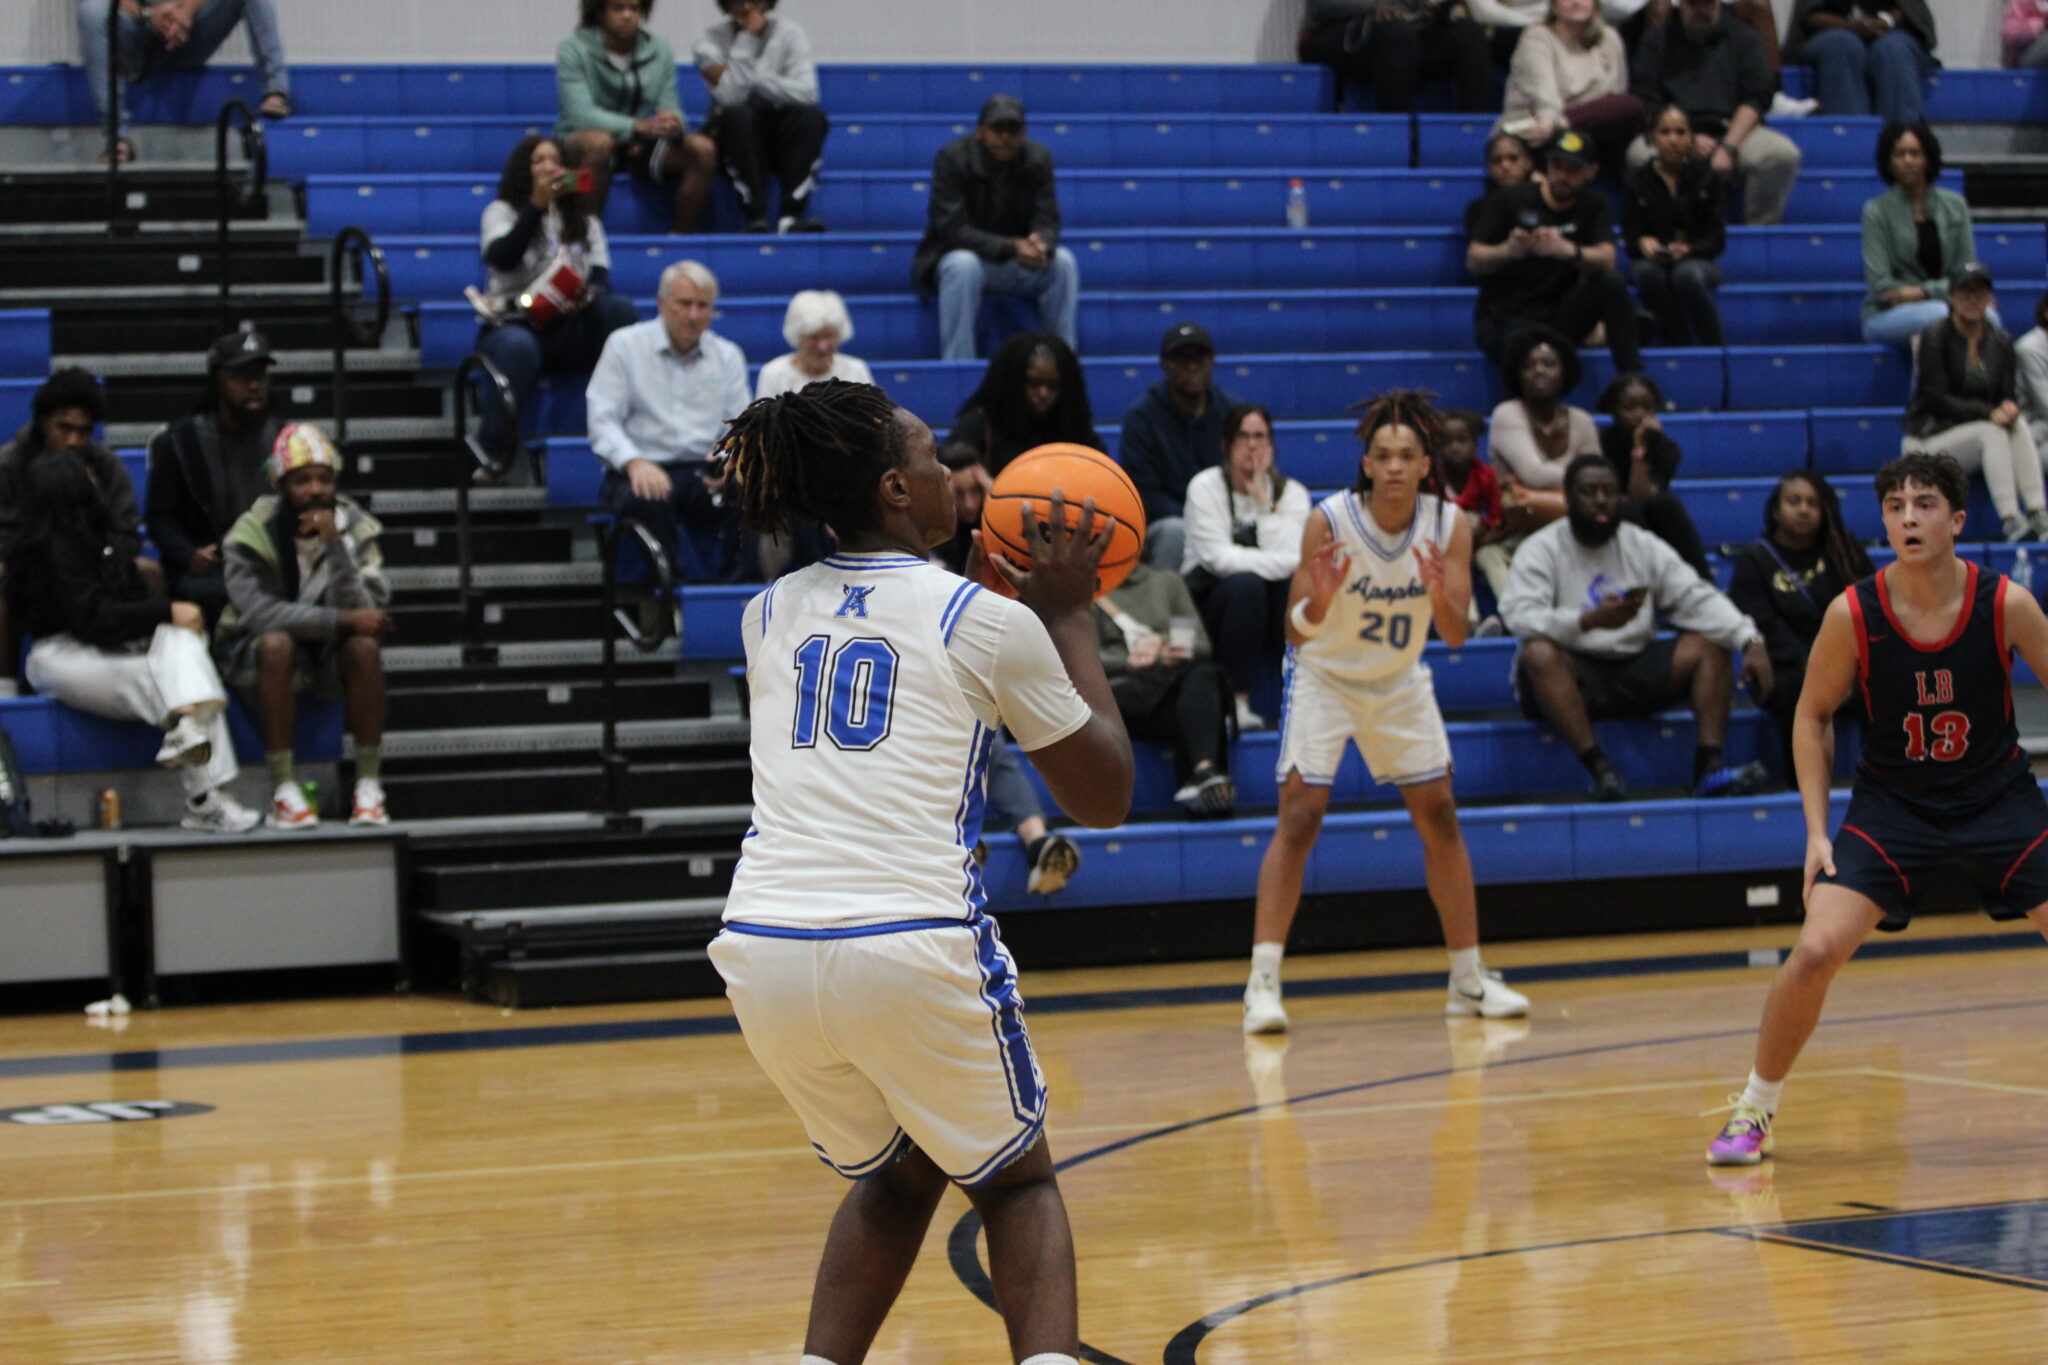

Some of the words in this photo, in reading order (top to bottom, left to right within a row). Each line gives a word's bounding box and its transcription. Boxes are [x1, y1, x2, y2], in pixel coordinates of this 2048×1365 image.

[834, 584, 870, 618] A
[1359, 611, 1412, 651] 20
[791, 634, 900, 752] 10
[1915, 668, 1954, 706] LB
[1903, 710, 1970, 761] 13
